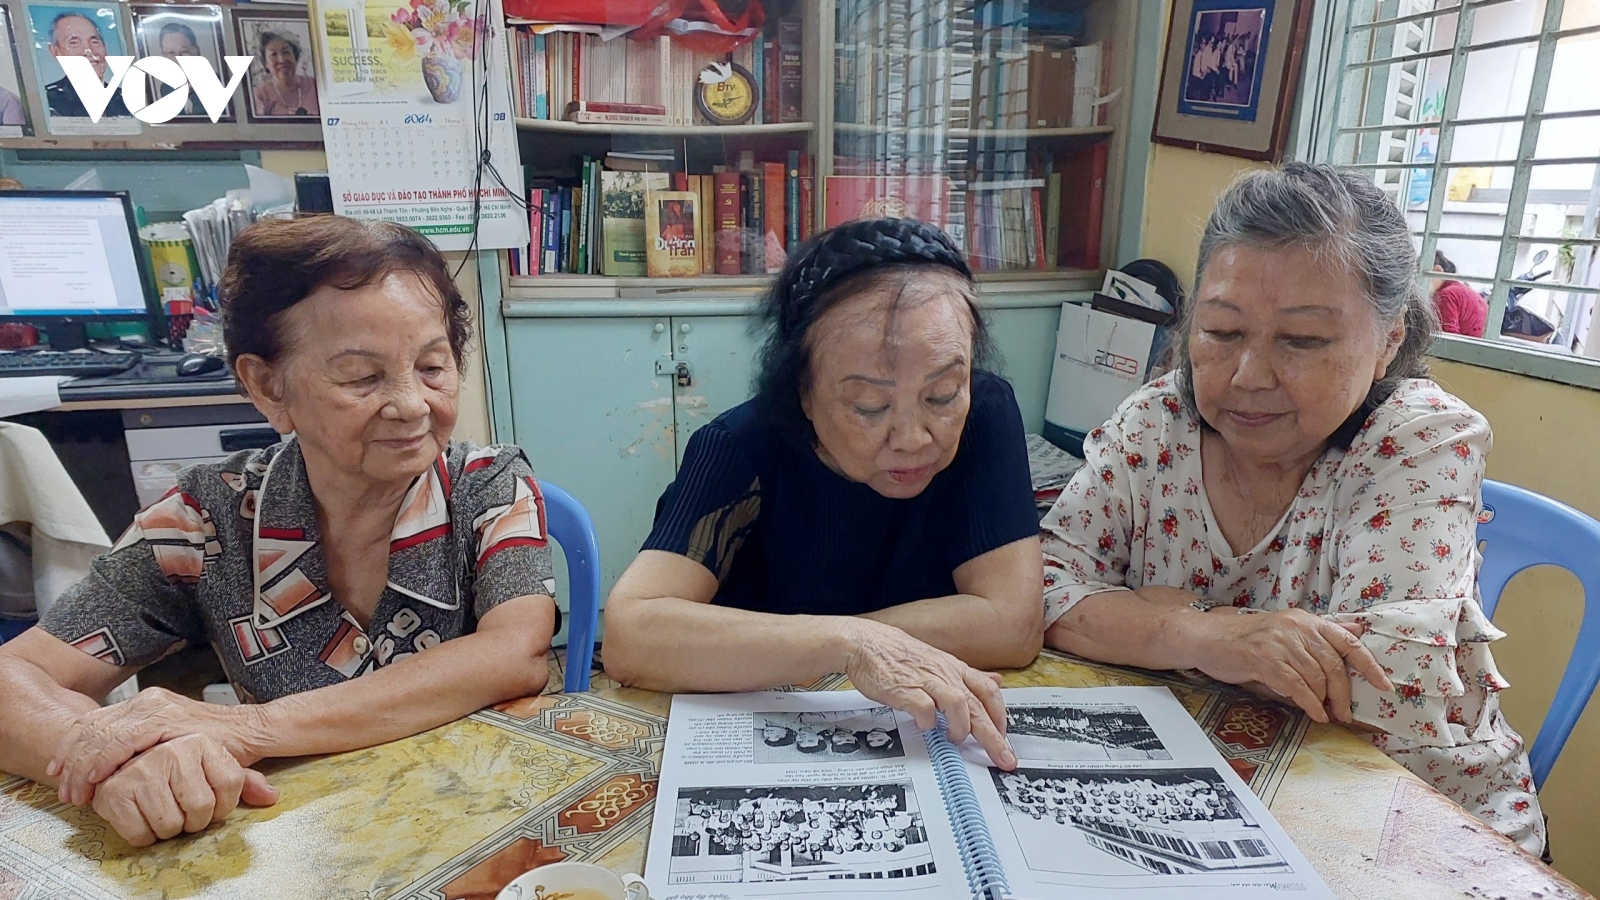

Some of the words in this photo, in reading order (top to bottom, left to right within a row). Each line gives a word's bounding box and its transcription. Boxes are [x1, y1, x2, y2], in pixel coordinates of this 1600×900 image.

[333, 56, 383, 66] SUCCESS,
[716, 82, 735, 92] BTV
[494, 113, 506, 121] 08
[343, 190, 351, 202] SỞ
[353, 190, 370, 202] GIÁO
[372, 192, 386, 203] DỤC
[387, 189, 397, 201] VÀ
[398, 189, 412, 200] ĐÀO
[413, 191, 427, 202] TẠO
[429, 188, 452, 199] THÀNH
[453, 186, 467, 198] PHỐ
[480, 186, 491, 198] CHÍ
[1094, 349, 1138, 375] 2023
